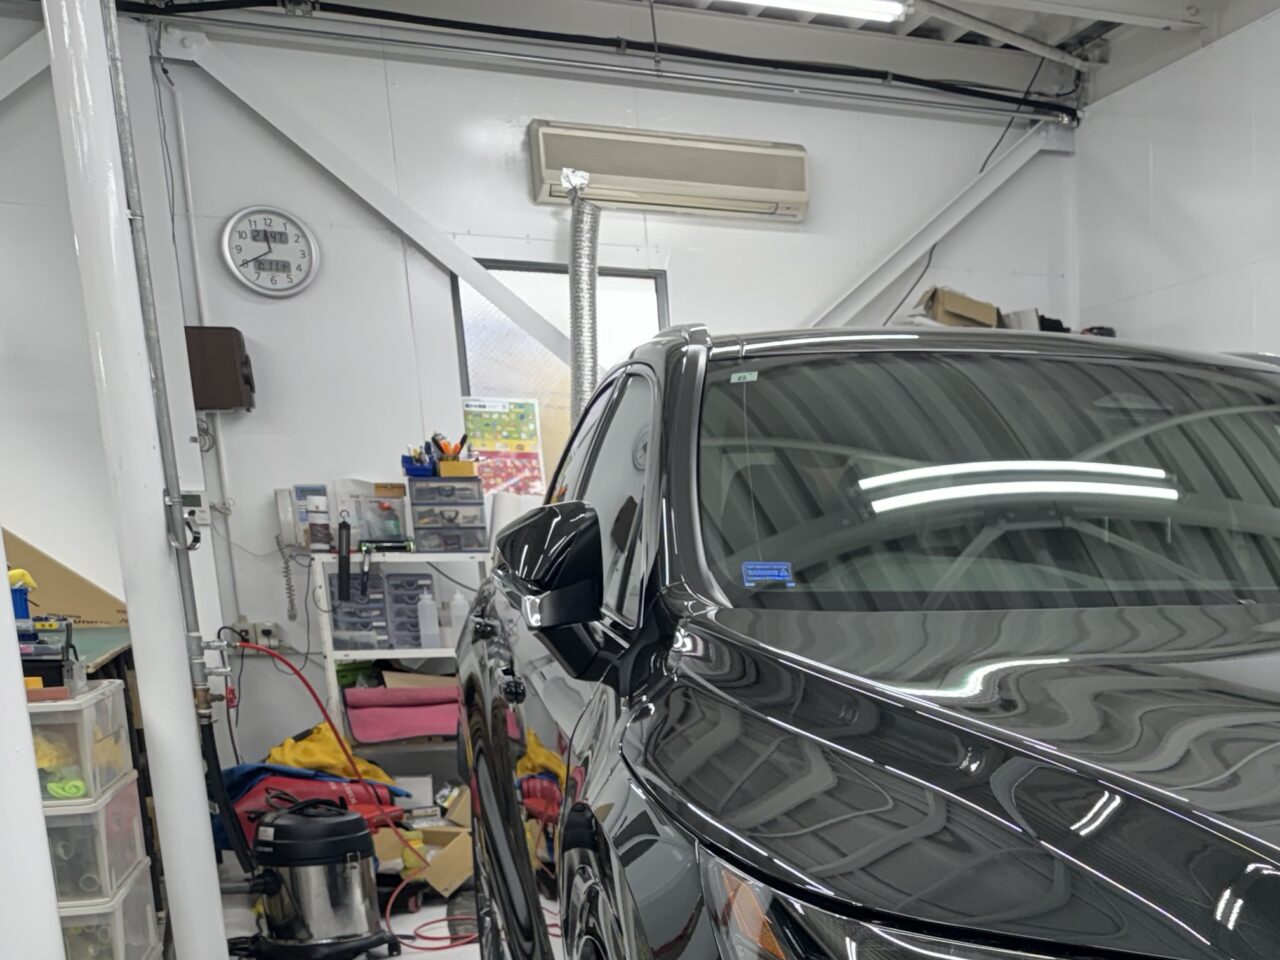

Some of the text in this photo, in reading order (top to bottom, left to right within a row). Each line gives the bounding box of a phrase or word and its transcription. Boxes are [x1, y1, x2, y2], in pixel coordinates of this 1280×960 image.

[248, 219, 257, 228] 11
[263, 218, 272, 227] 12
[238, 230, 248, 240] 10
[294, 234, 300, 243] 2
[235, 245, 242, 254] 9
[300, 250, 306, 259] 3
[296, 264, 302, 272] 4
[254, 272, 261, 281] 7
[270, 276, 277, 285] 6
[286, 274, 293, 283] 5
